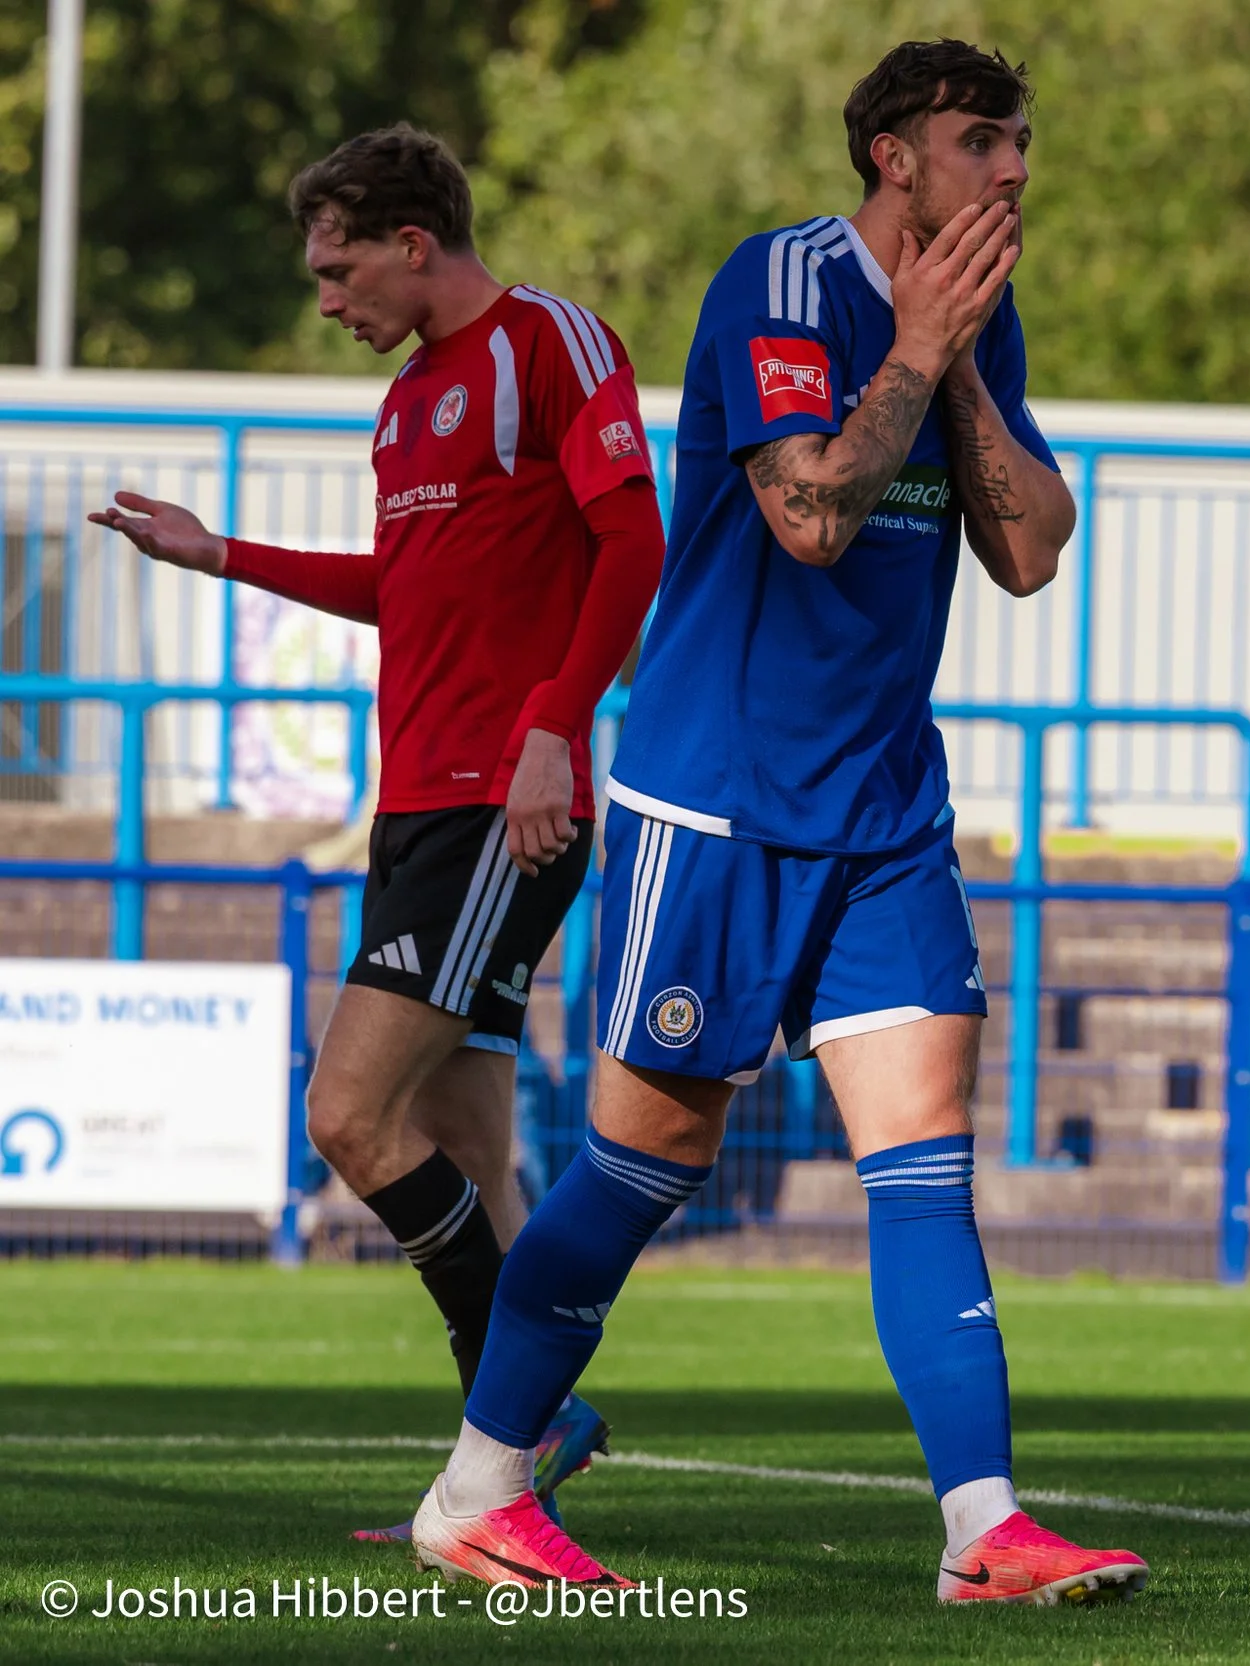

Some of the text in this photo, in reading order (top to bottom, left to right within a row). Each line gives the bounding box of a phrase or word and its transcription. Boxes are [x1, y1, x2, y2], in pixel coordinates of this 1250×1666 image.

[615, 424, 626, 436] &
[418, 483, 457, 501] SOLAR
[655, 991, 683, 1008] CURZON
[97, 993, 254, 1029] MONEY
